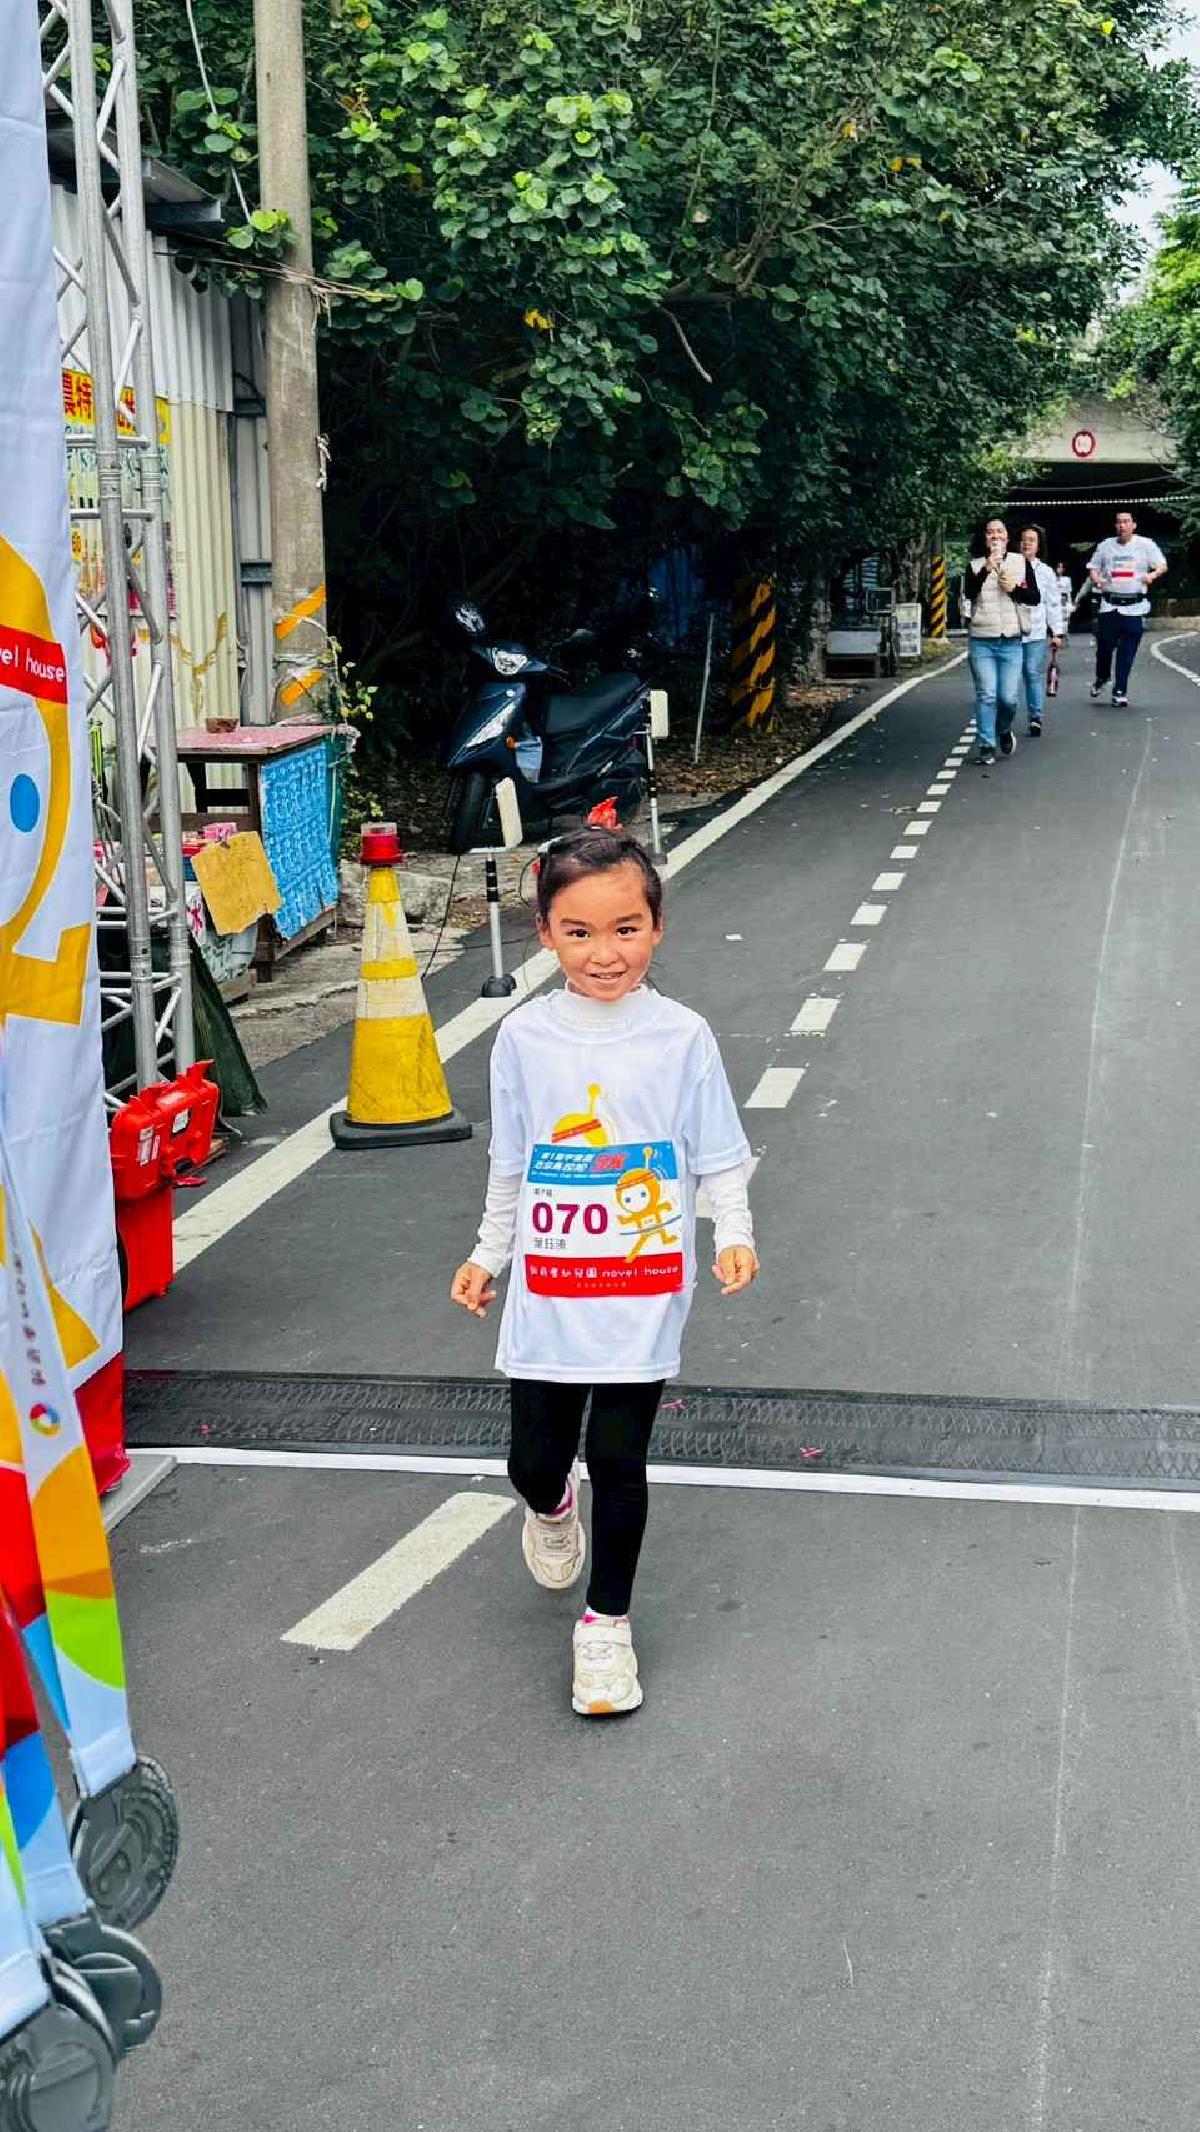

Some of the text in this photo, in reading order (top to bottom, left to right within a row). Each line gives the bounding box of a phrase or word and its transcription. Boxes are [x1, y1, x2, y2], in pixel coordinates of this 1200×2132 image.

[0, 645, 64, 682] el house
[532, 1202, 608, 1234] 070
[602, 1268, 638, 1279] novel
[644, 1265, 679, 1276] house
